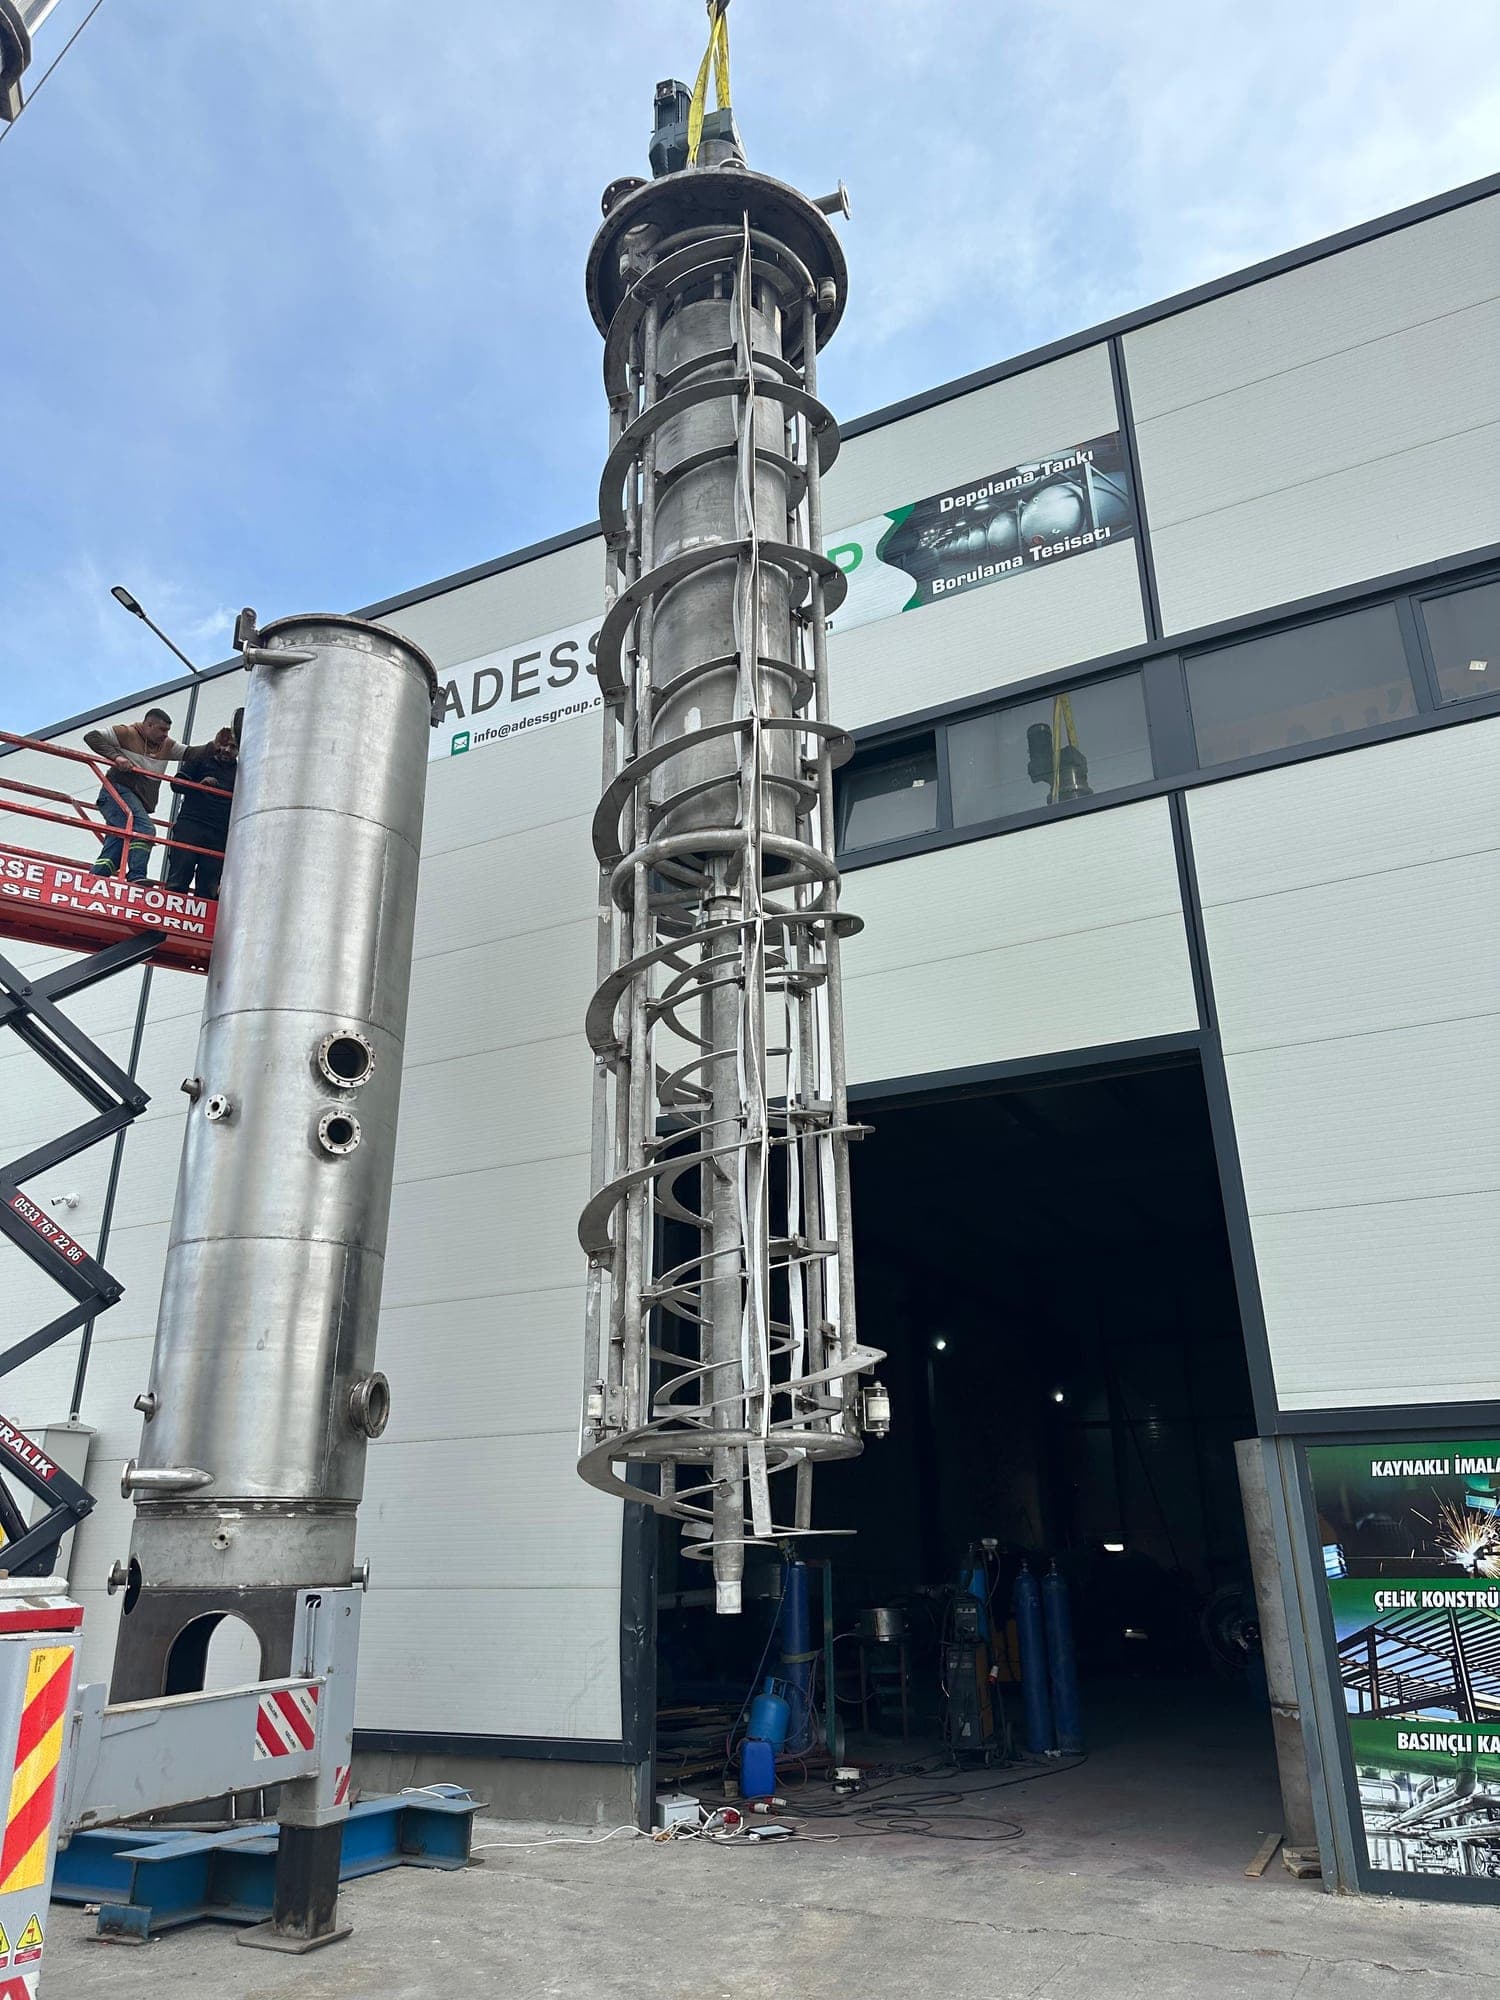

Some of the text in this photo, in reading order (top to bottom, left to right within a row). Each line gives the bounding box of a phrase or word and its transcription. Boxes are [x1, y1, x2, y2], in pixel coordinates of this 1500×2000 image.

[939, 449, 1094, 513] Depolama Tankı
[932, 526, 1112, 595] Borulama Tesisatı
[473, 697, 602, 744] info@adessgroup.c
[51, 892, 205, 934] PLATFORM
[55, 870, 207, 919] PLATFORM
[14, 1197, 83, 1261] 0533 767 22 86
[0, 1421, 54, 1478] RALIK
[1371, 1459, 1450, 1477] KAYNAKLI
[1422, 1587, 1500, 1608] KONSTRÜ
[1397, 1732, 1472, 1757] BASINÇLI
